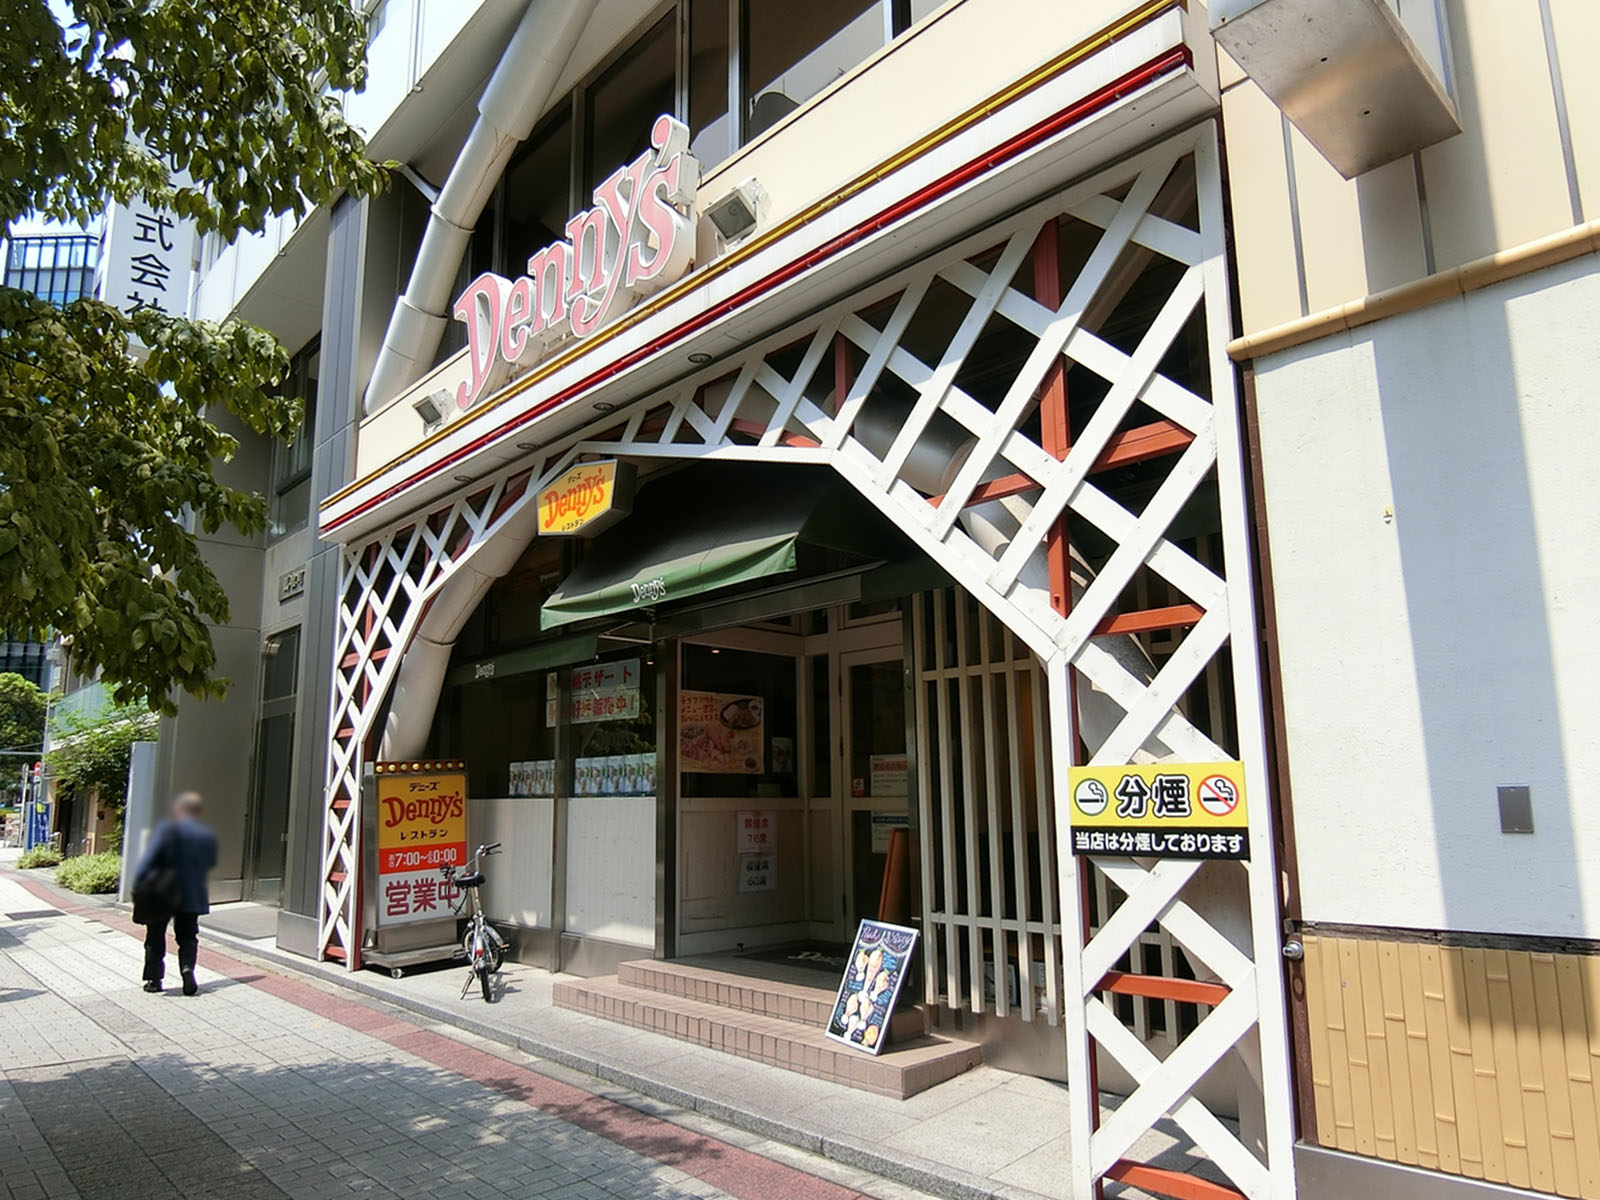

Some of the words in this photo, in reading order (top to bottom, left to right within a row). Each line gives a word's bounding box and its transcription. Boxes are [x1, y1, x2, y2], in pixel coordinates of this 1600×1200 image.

[453, 114, 686, 410] Denny's
[544, 467, 606, 529] Denny's
[630, 577, 666, 603] Denny's
[409, 781, 440, 792] デニーズ
[1114, 774, 1192, 819] 分煙
[382, 791, 464, 828] Denny's
[400, 829, 448, 840] レストラン
[1075, 831, 1243, 853] 当店は分煙しております
[386, 876, 461, 917] 営業中
